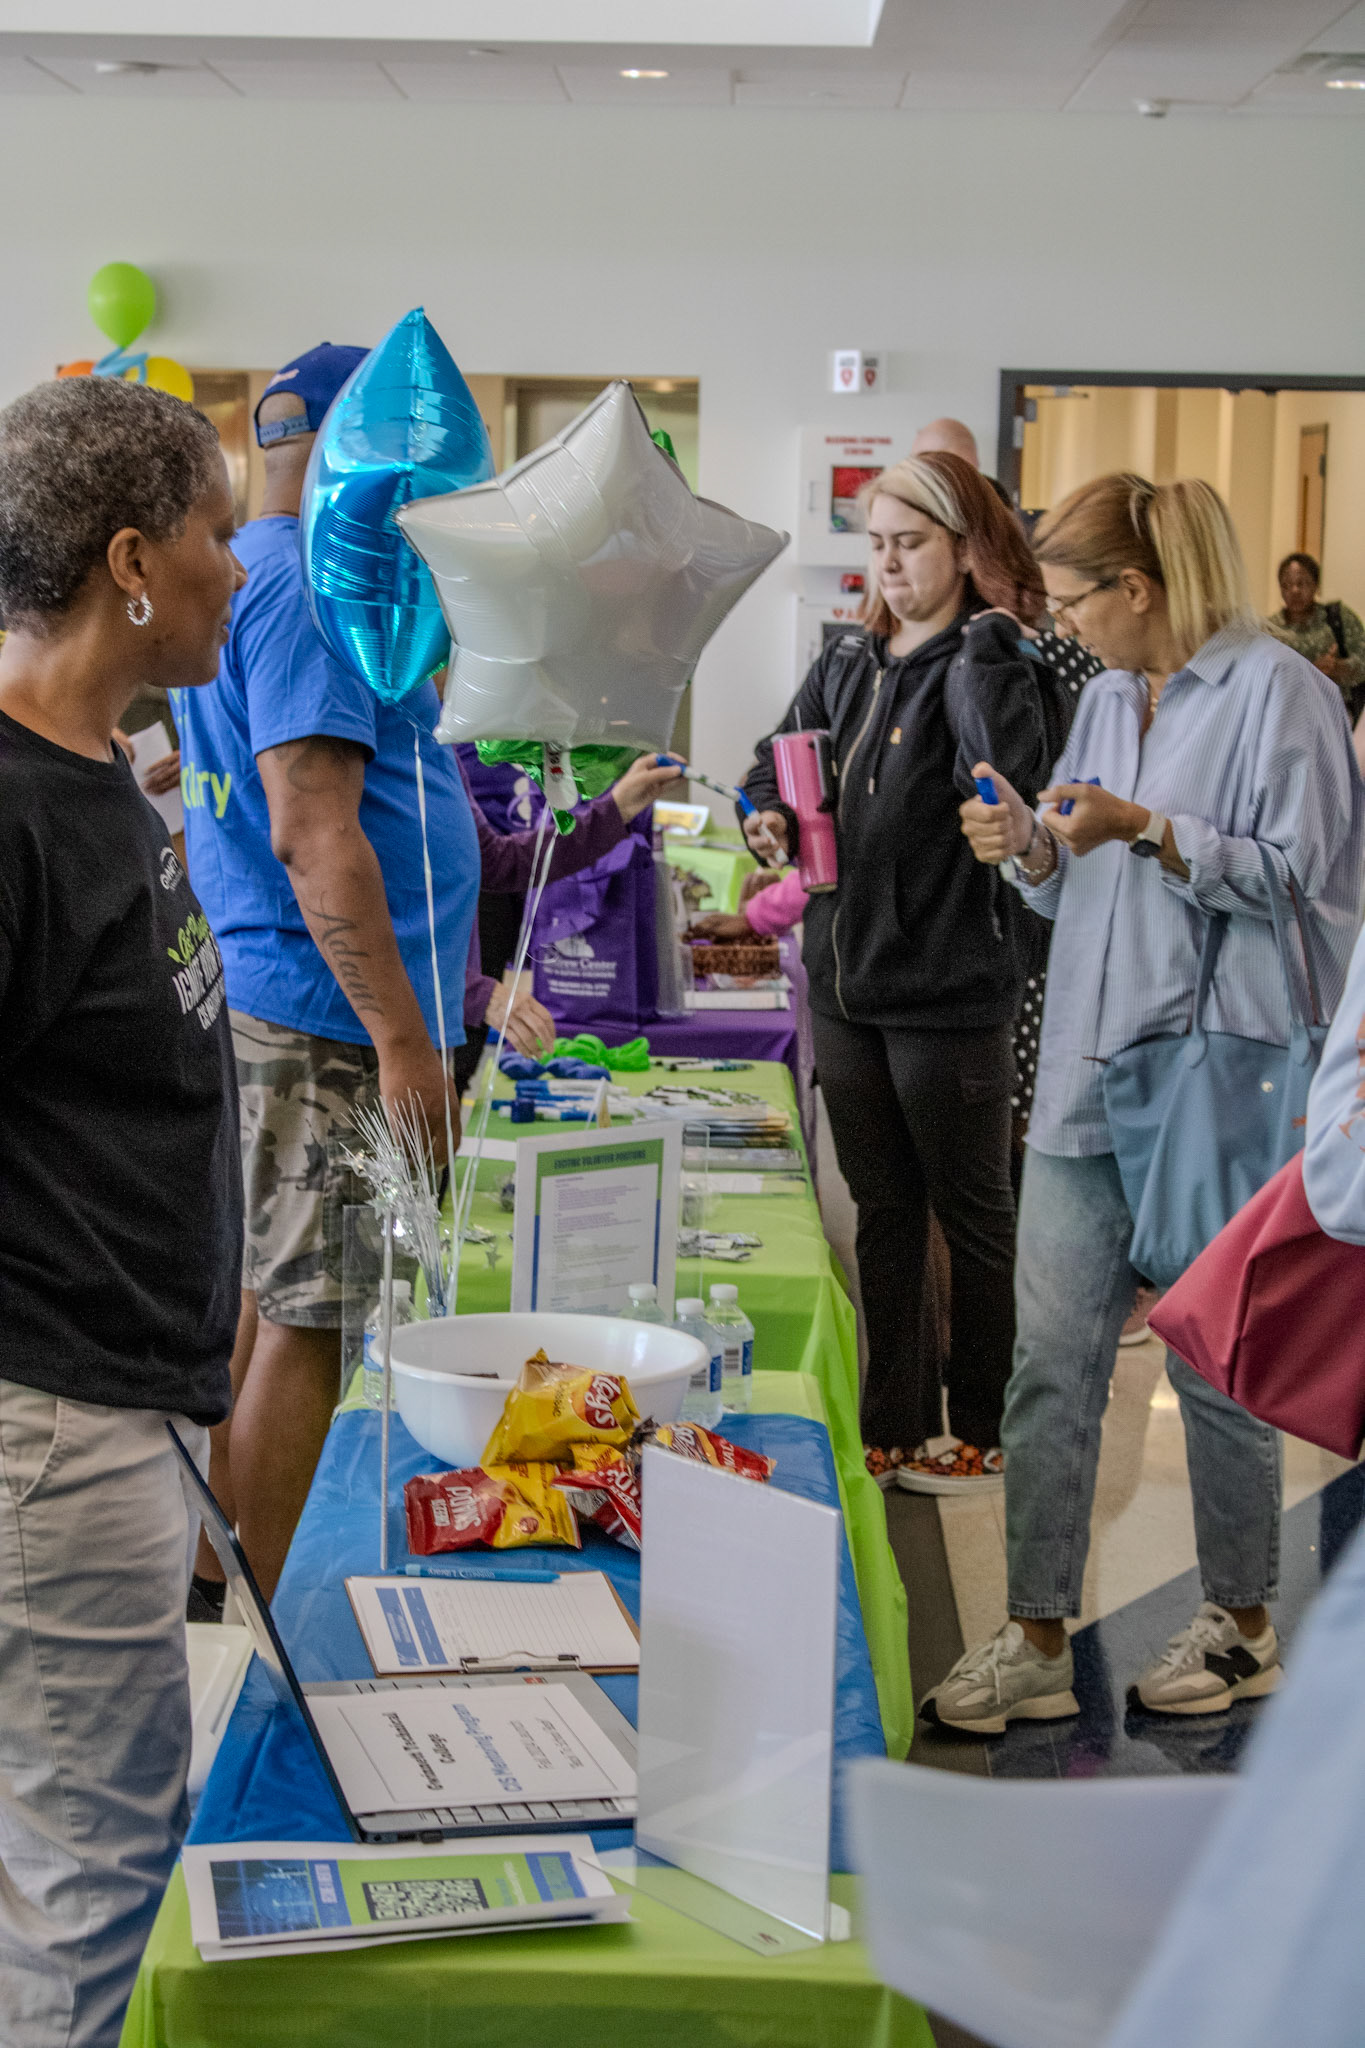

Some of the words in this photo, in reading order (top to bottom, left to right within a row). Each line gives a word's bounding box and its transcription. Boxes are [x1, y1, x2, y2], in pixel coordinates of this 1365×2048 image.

[584, 1375, 621, 1428] Lays
[382, 1712, 419, 1750] Technical
[453, 1704, 480, 1734] Program
[428, 1734, 455, 1763] College
[474, 1735, 509, 1776] Mentoring
[409, 1752, 444, 1789] Gwinnett
